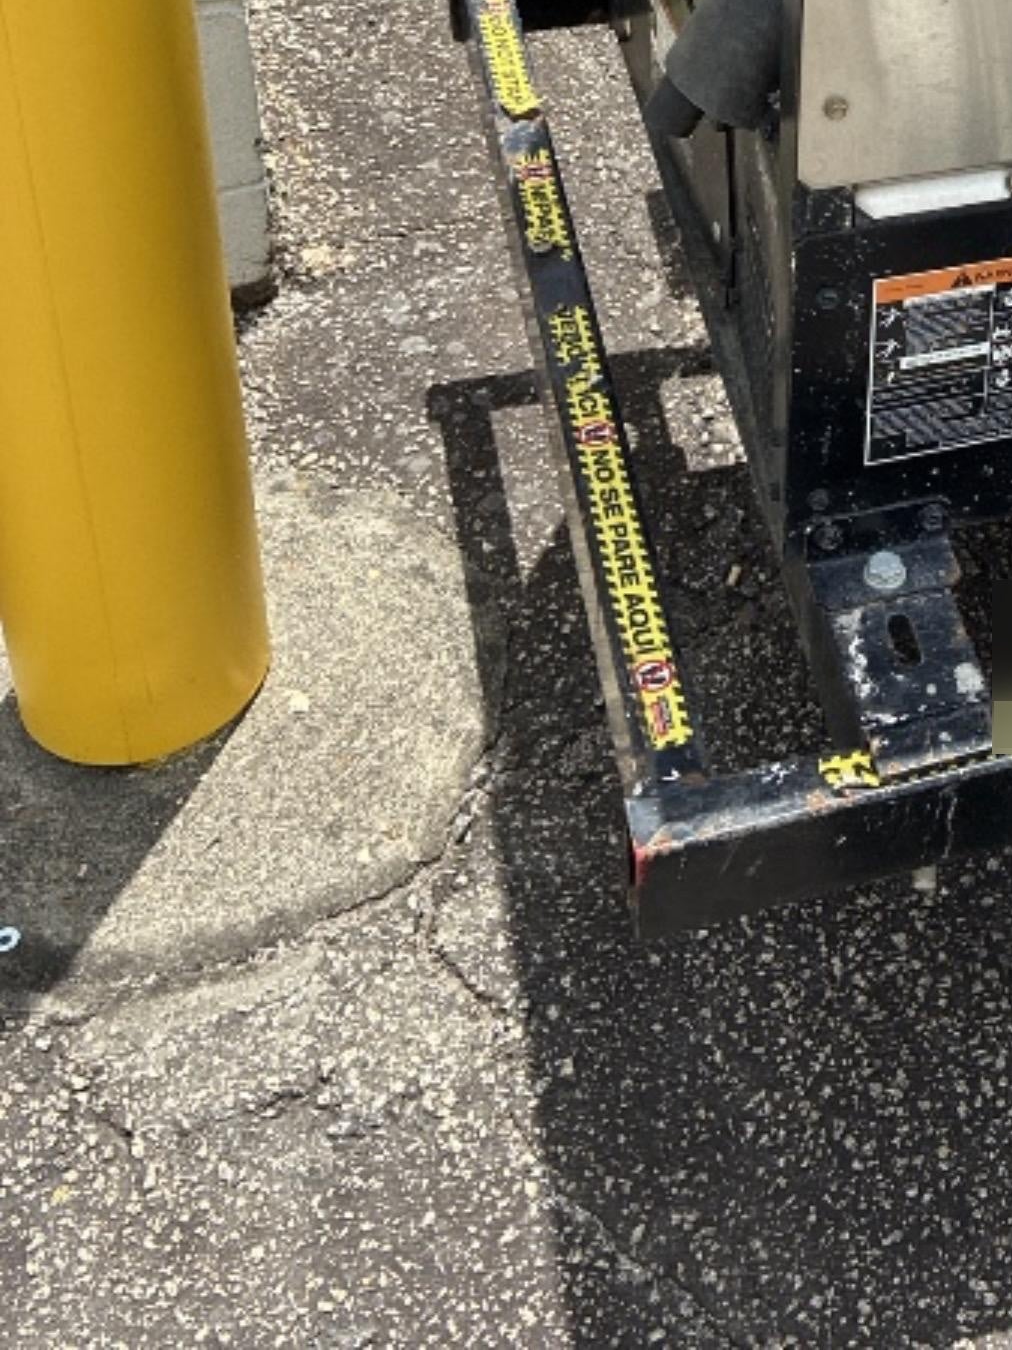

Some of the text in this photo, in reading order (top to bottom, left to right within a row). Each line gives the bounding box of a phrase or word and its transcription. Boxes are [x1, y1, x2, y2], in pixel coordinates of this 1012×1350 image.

[592, 448, 614, 484] NO
[599, 487, 621, 519] SE
[608, 522, 640, 588] PARE
